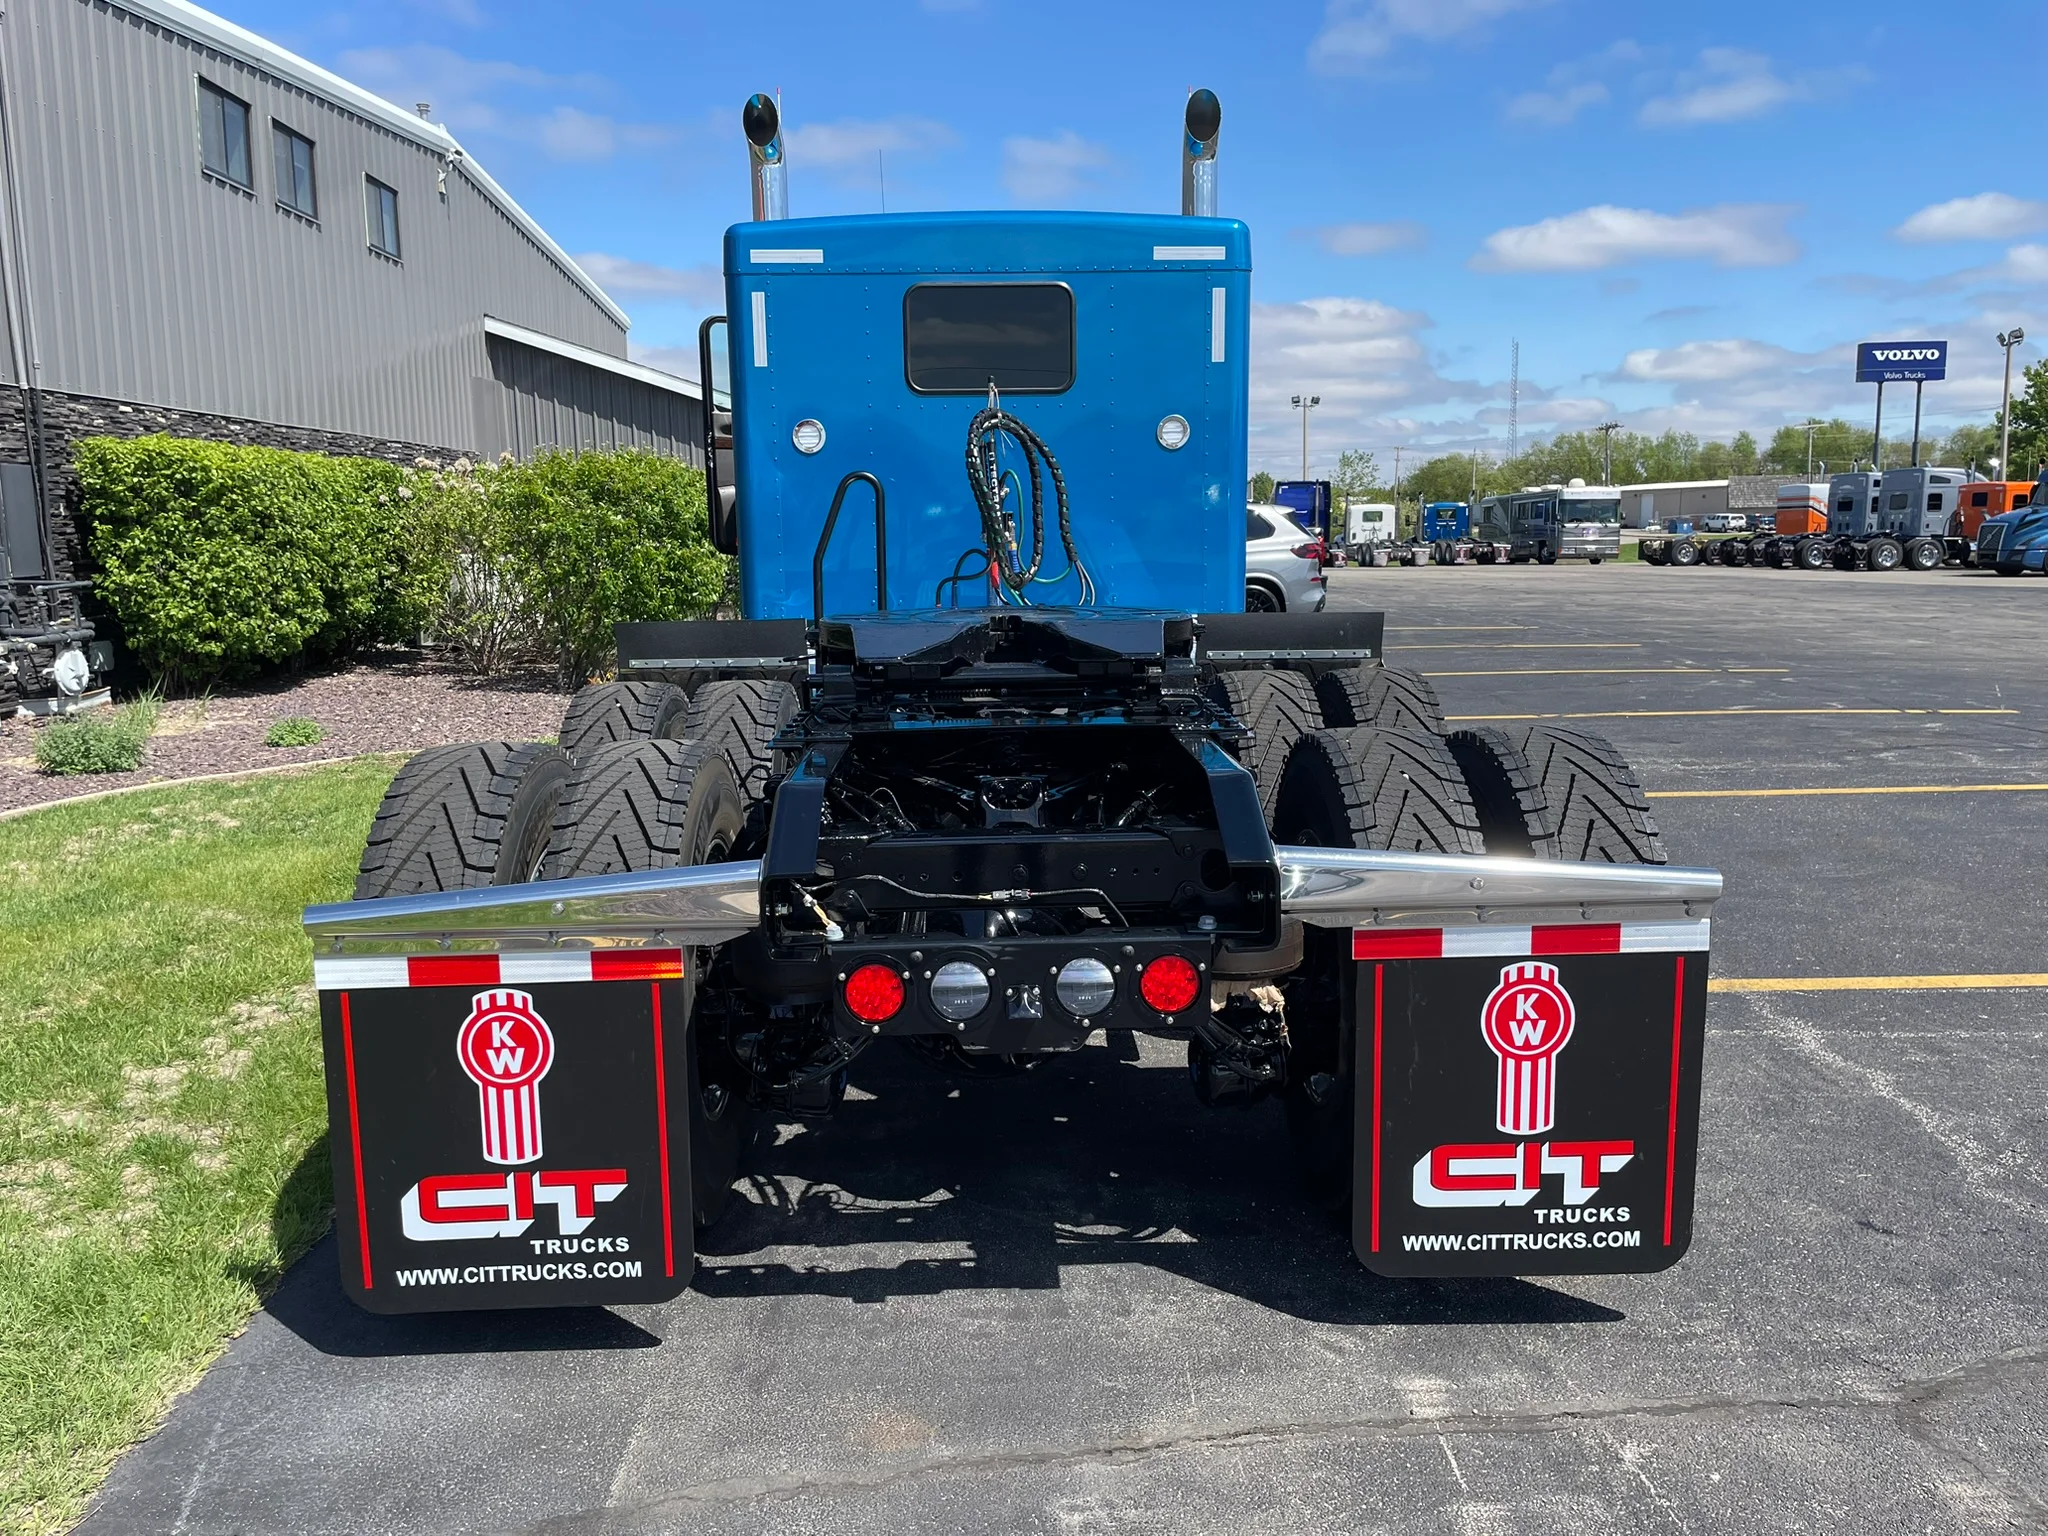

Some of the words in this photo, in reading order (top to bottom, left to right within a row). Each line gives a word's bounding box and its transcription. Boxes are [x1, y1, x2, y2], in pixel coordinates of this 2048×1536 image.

[1872, 349, 1939, 361] VOLVO
[1883, 371, 1902, 380] Volvo
[1904, 371, 1926, 379] Trucks
[1413, 1140, 1635, 1208] CIT
[401, 1169, 628, 1241] CIT
[1533, 1206, 1631, 1224] TRUCKS
[529, 1236, 630, 1255] TRUCKS
[1402, 1230, 1641, 1252] WWW.CITTRUCKS.COM
[396, 1261, 642, 1286] WWW.CITTRUCKS.COM
